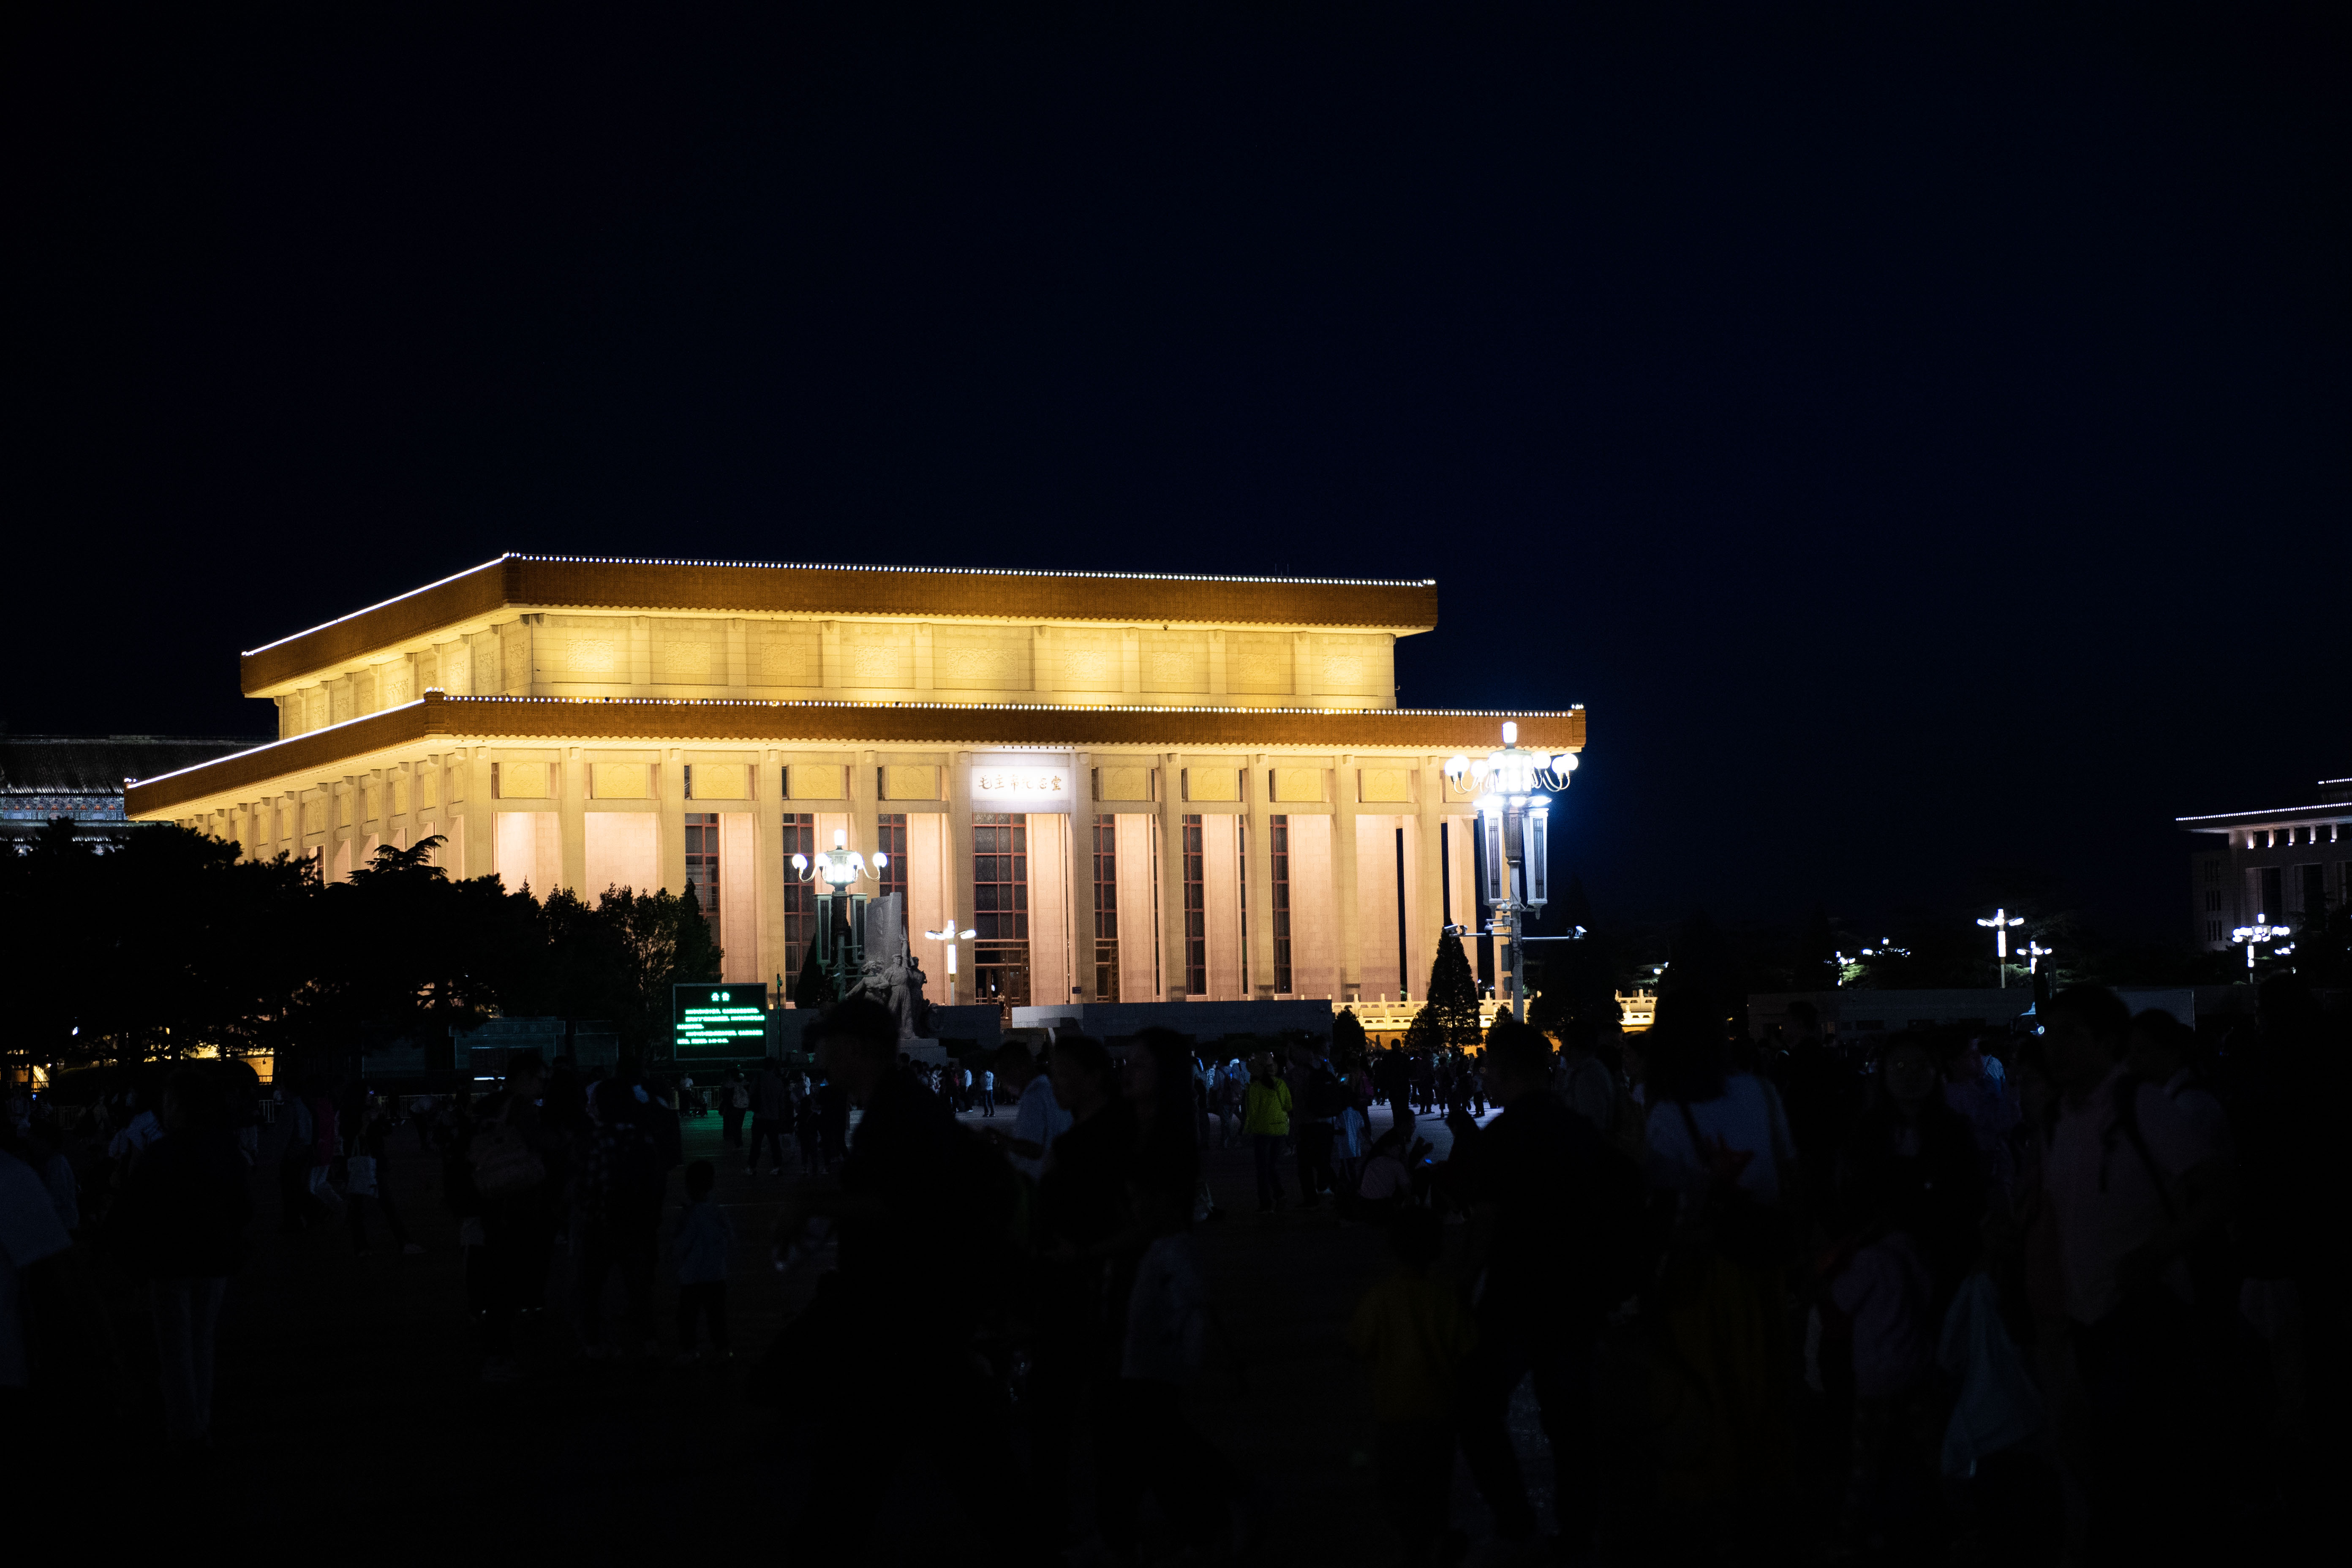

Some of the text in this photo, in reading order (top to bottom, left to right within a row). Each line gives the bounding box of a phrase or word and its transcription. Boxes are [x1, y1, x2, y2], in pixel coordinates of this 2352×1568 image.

[978, 774, 1062, 793] 毛主席纪念堂
